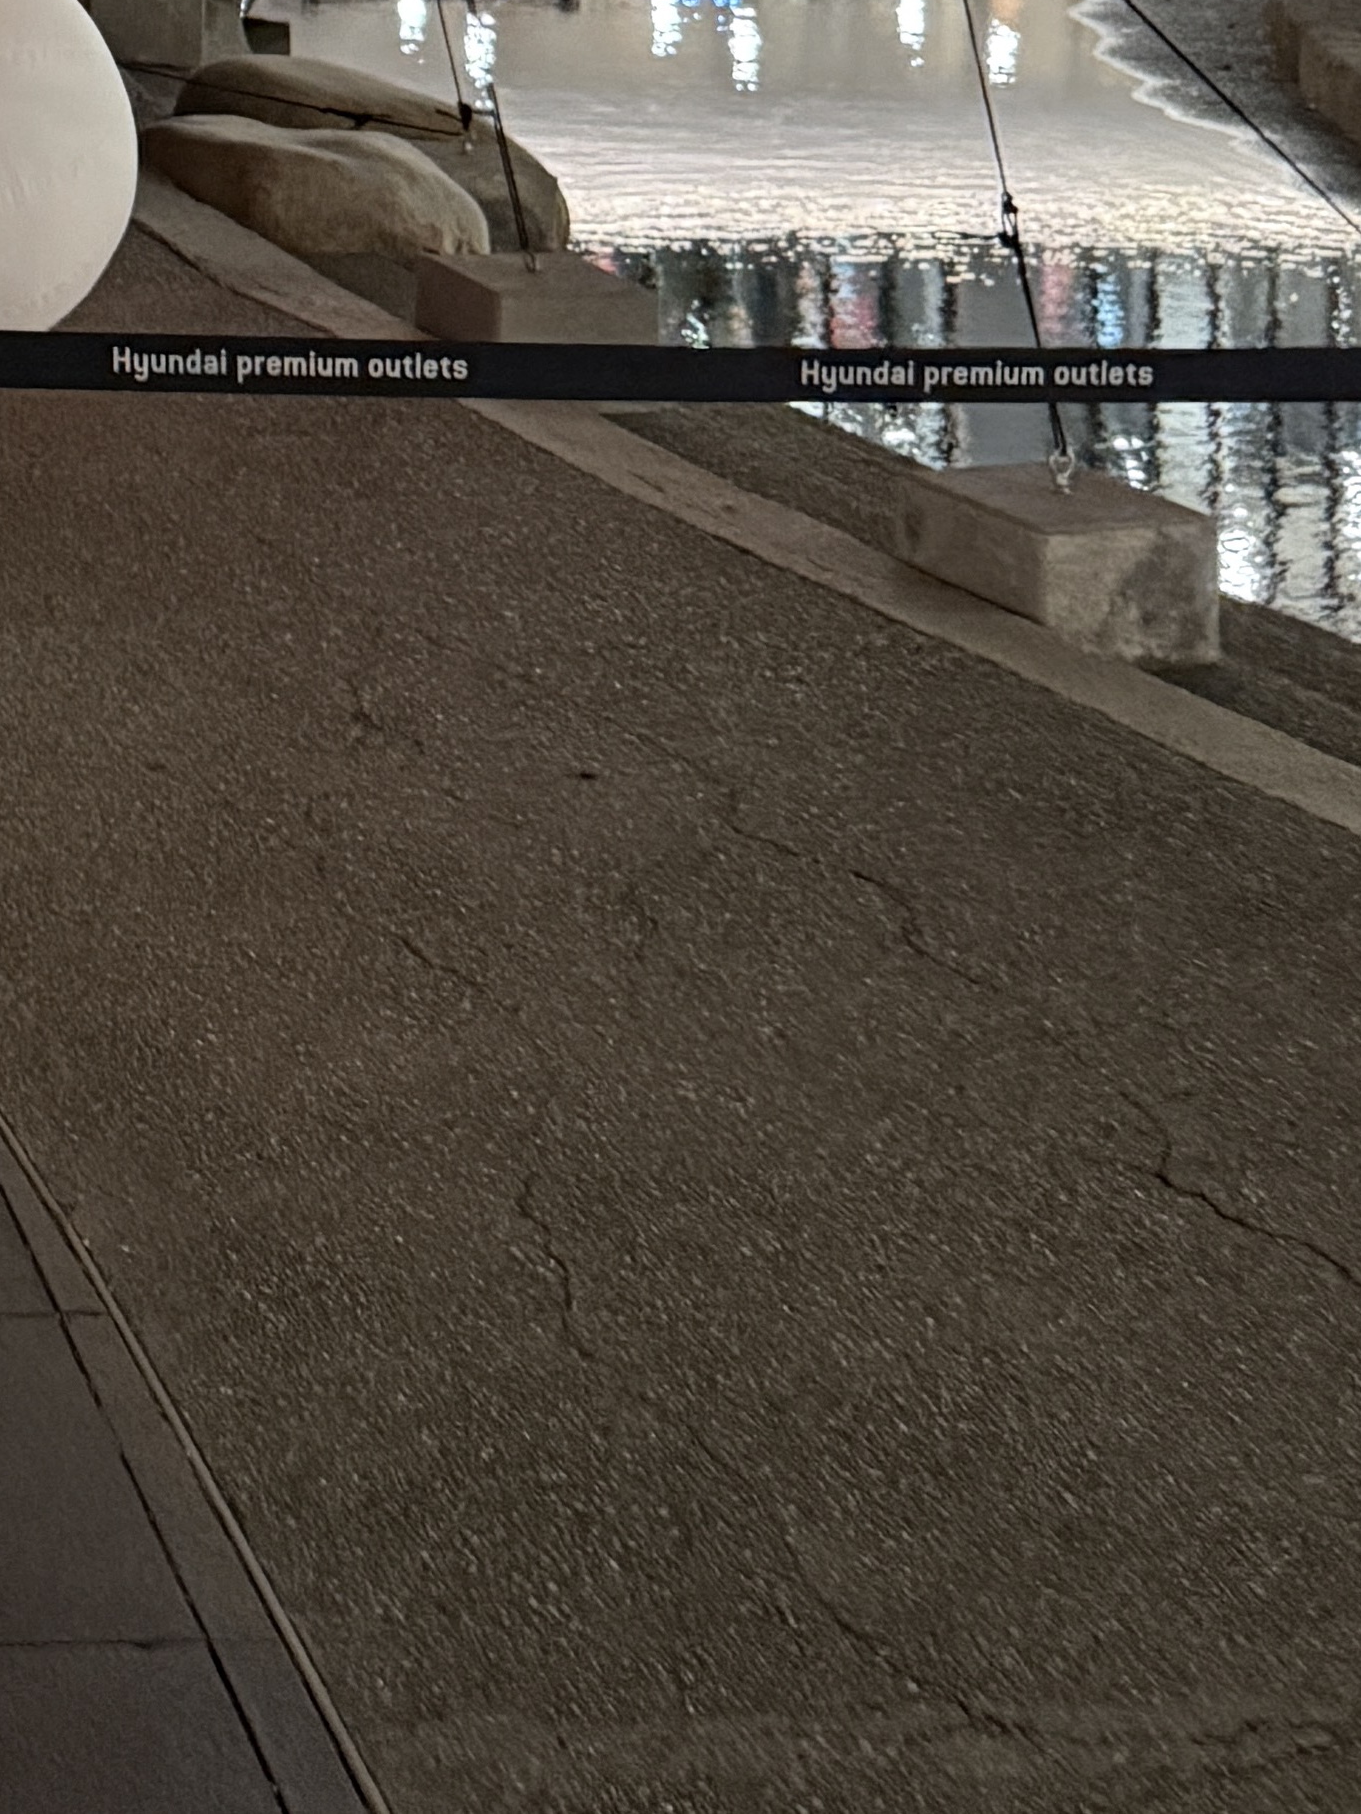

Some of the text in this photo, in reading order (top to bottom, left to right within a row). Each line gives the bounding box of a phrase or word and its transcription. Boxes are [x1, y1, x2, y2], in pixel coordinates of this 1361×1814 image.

[112, 346, 468, 383] Hyundai premium outlets
[801, 359, 1153, 393] Hyundai premium outlets
